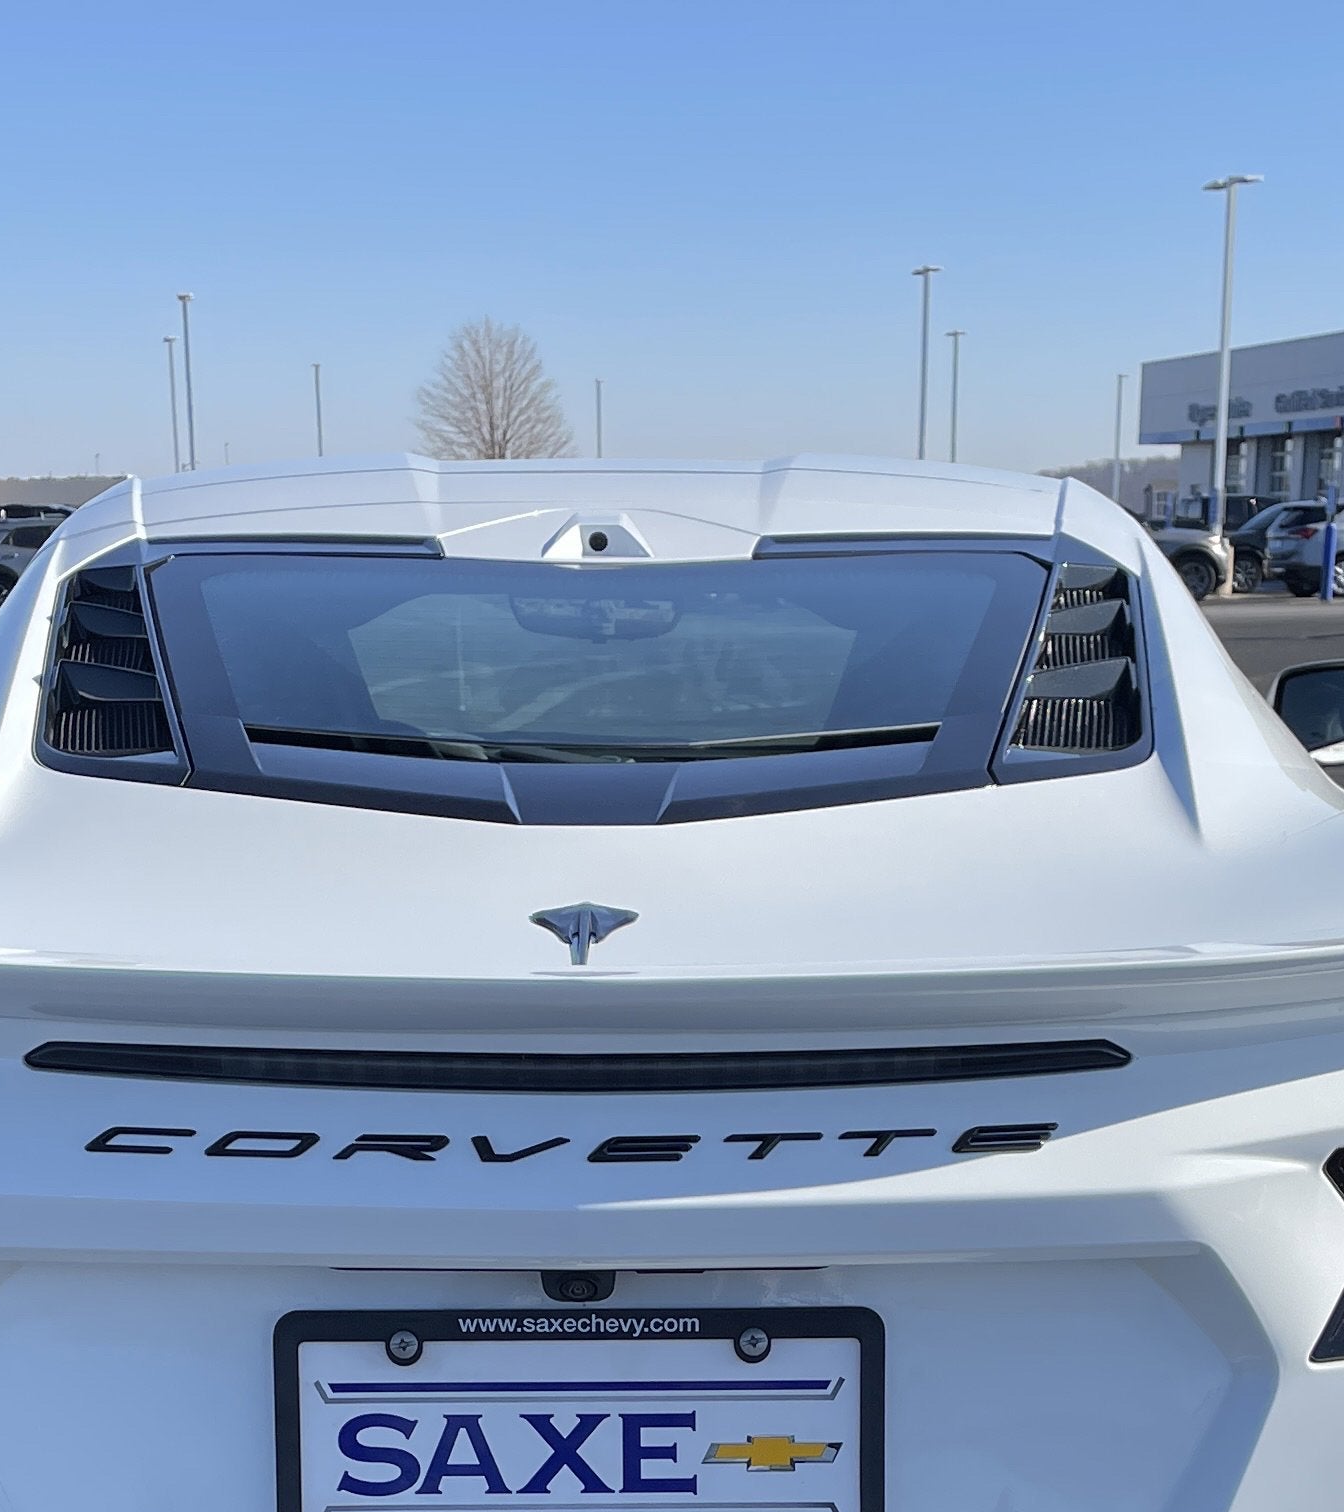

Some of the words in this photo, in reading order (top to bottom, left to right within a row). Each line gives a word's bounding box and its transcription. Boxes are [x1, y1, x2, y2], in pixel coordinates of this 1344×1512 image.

[85, 1122, 1060, 1163] CORVETTE
[458, 1314, 701, 1338] www.saxechevy.com
[336, 1410, 699, 1497] SAXE
